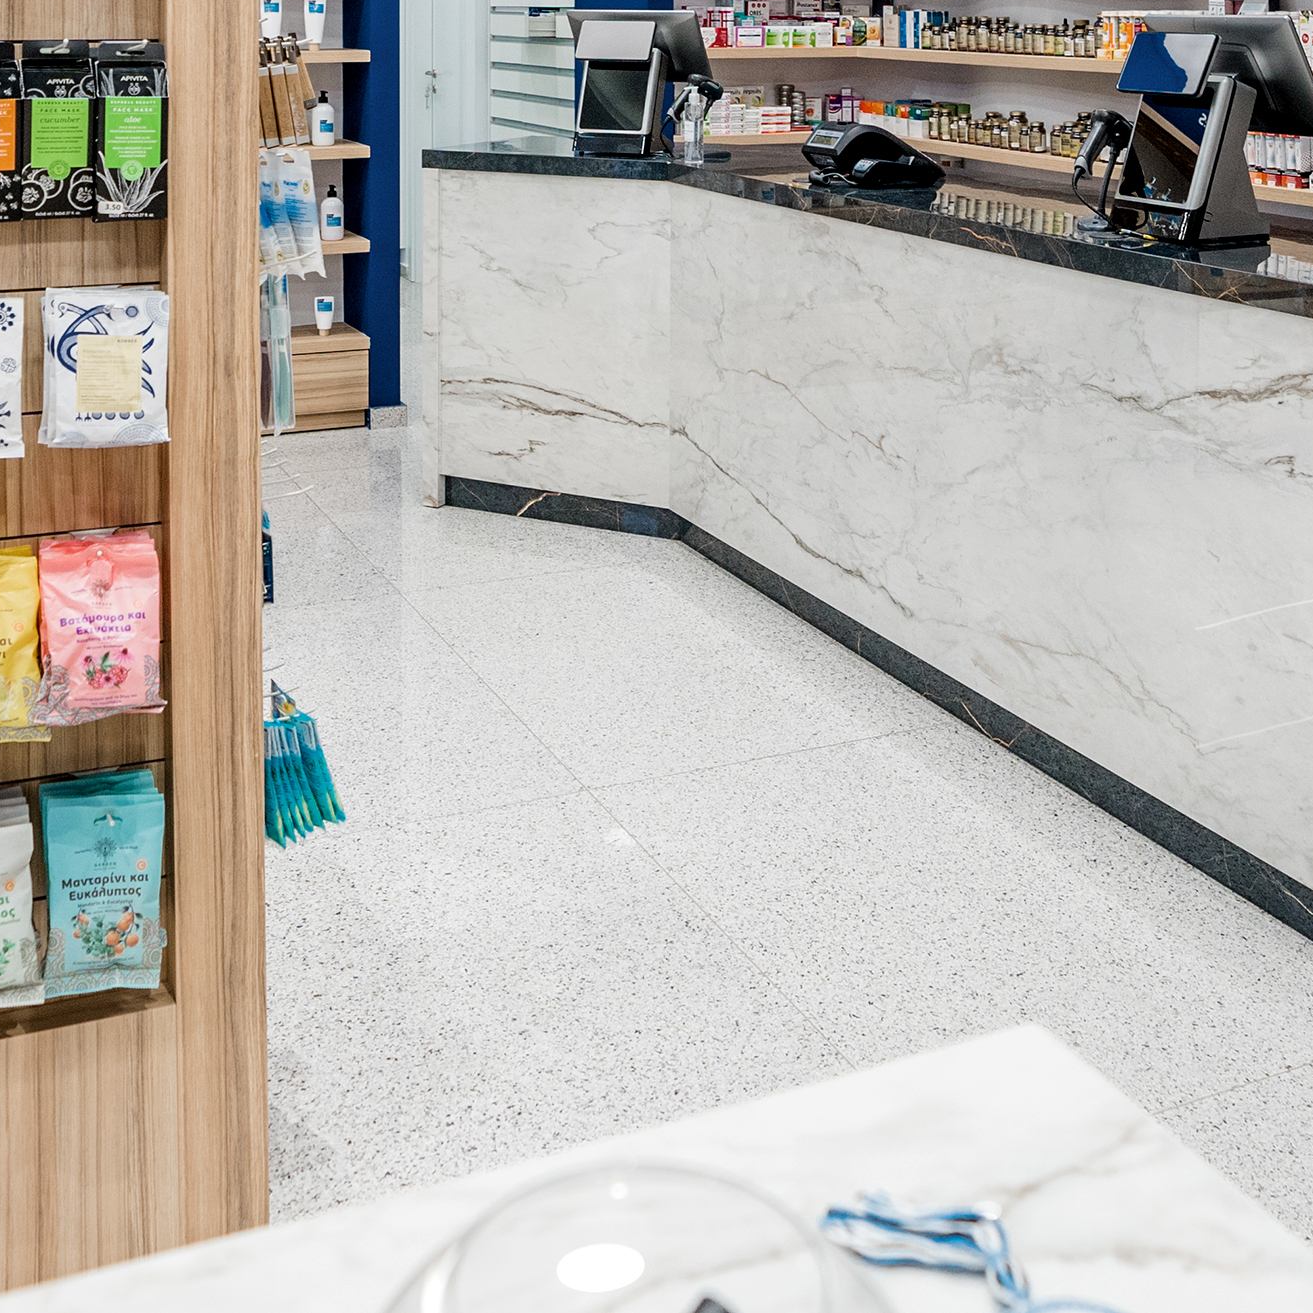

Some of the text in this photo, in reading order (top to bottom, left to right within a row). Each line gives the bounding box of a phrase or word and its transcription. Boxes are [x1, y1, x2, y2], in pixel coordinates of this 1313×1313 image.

[47, 78, 75, 86] APIVITA
[121, 75, 148, 83] APIVITA
[40, 116, 80, 124] cucumber
[124, 116, 141, 124] aloe
[105, 203, 121, 211] 3.50
[128, 609, 146, 620] και
[62, 873, 149, 890] Μανταρίνι και
[69, 885, 141, 901] Ευκάλυπτος
